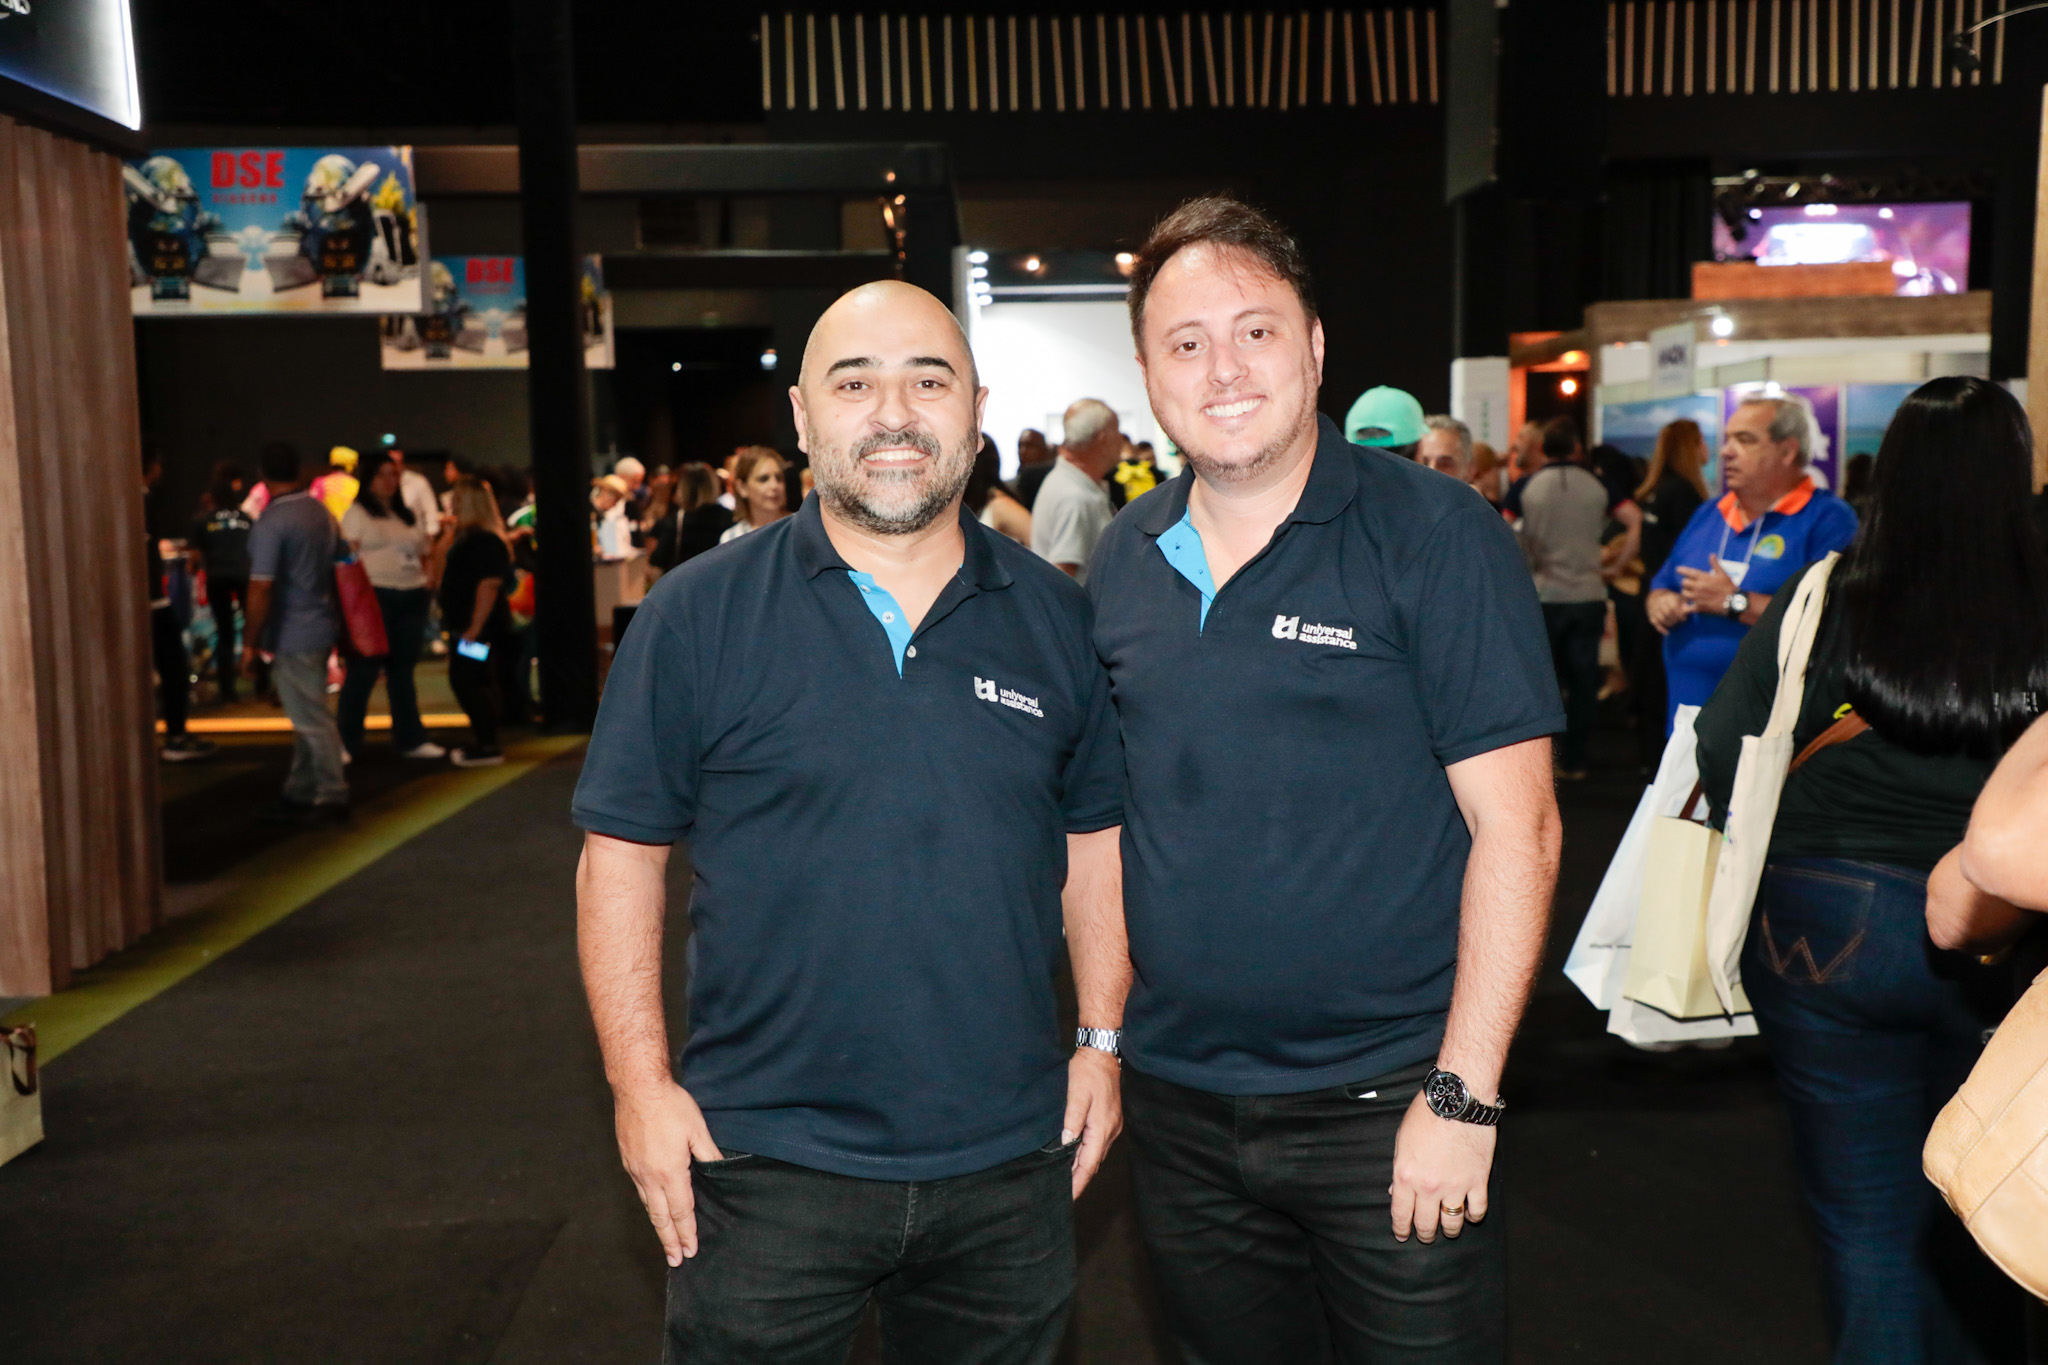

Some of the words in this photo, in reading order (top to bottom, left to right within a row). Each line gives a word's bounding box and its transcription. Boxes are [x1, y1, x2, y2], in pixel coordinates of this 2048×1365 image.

[211, 150, 285, 188] DSE
[466, 257, 515, 283] DSE
[1298, 631, 1358, 650] assistance
[1301, 622, 1353, 640] universal
[1000, 687, 1039, 709] universal
